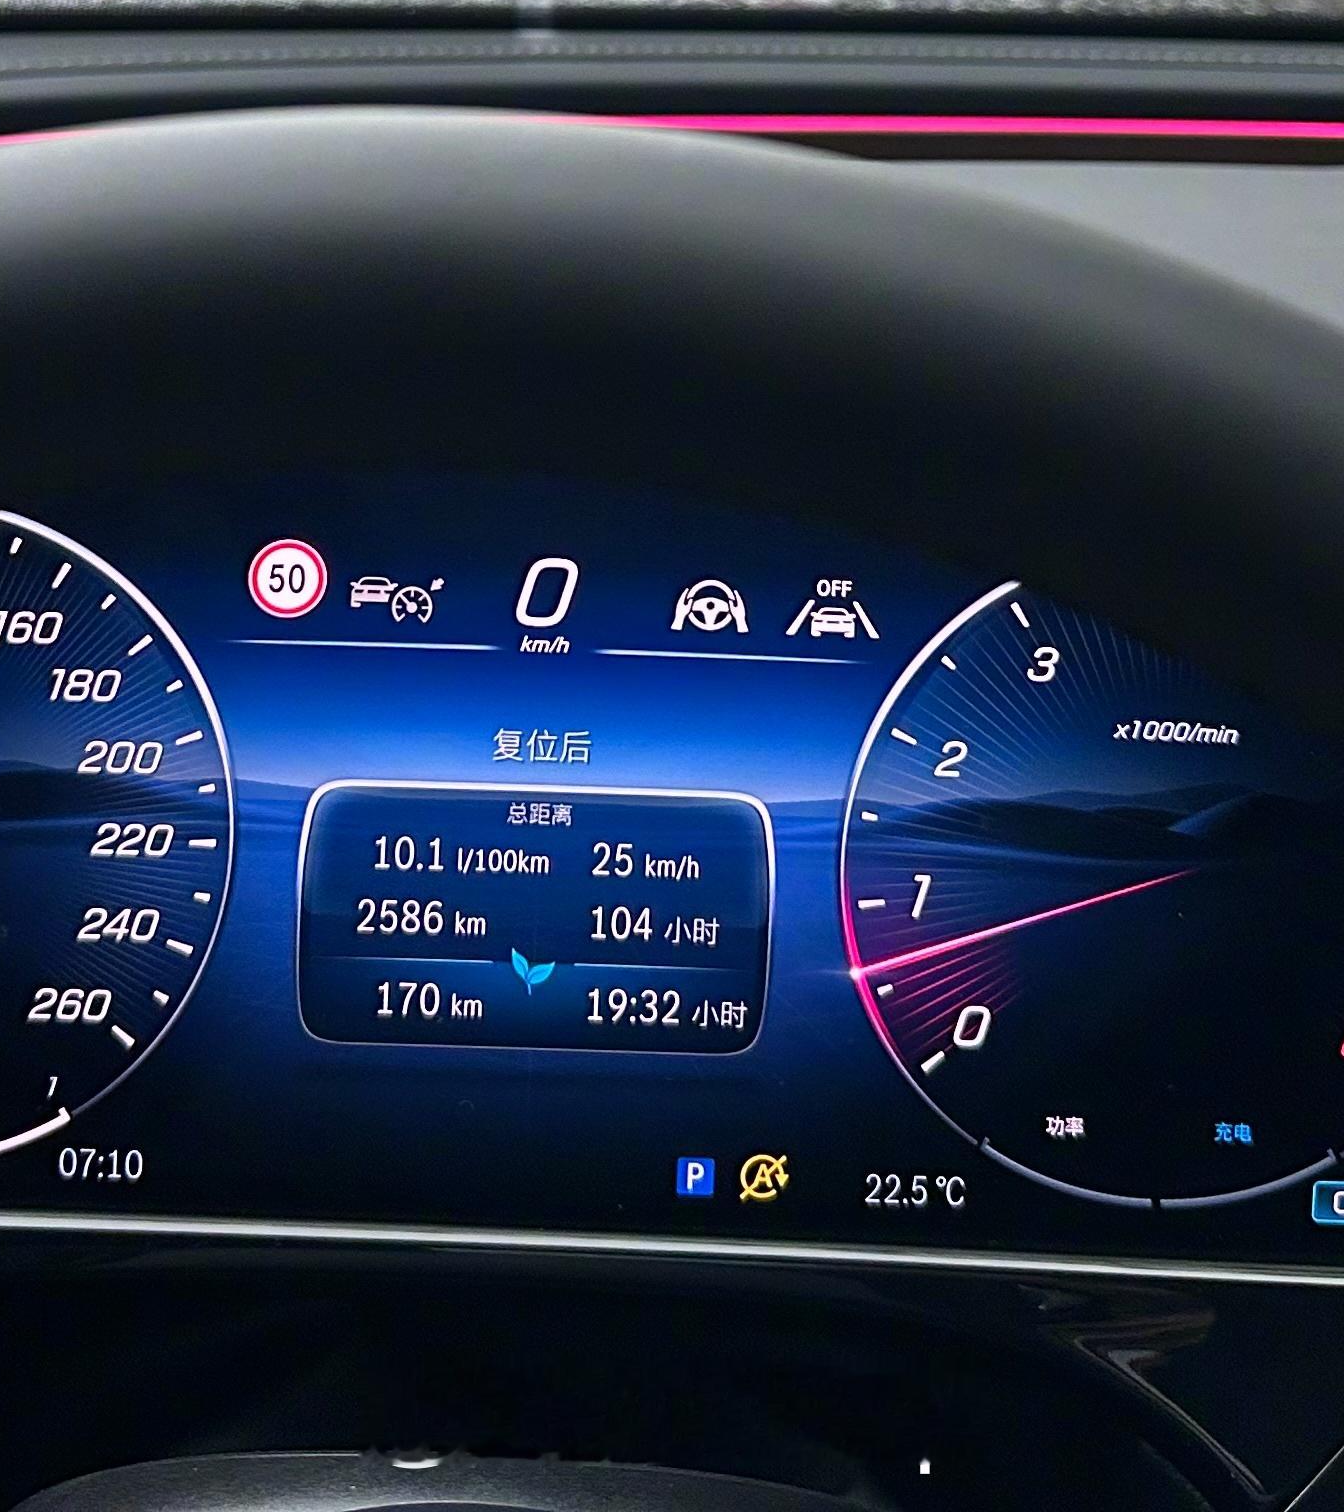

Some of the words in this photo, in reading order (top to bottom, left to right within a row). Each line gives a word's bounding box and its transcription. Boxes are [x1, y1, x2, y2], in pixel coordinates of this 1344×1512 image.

[269, 564, 305, 593] 50
[516, 558, 578, 626] 0
[816, 580, 852, 598] OFF
[520, 635, 569, 653] km/h
[1027, 647, 1059, 682] 3
[50, 669, 121, 703] 180
[492, 728, 591, 766] 复位后
[1113, 720, 1239, 744] x1000/min
[78, 740, 164, 774] 200
[934, 740, 967, 778] 2
[507, 803, 573, 826] 总距离
[90, 821, 175, 857] 220
[375, 836, 443, 871] 10.1
[458, 848, 549, 874] l/100km
[592, 842, 632, 877] 25
[645, 854, 699, 881] km/h
[912, 875, 931, 919] 1
[77, 906, 160, 942] 240
[357, 899, 443, 935] 2586
[455, 911, 485, 935] km
[591, 906, 652, 941] 104
[664, 916, 720, 945] 小时
[28, 988, 112, 1023] 260
[378, 982, 439, 1016] 170
[452, 993, 482, 1018] km
[588, 988, 679, 1023] 19:32
[692, 1000, 747, 1028] 小时
[954, 1003, 991, 1047] 0
[48, 1077, 57, 1097] 1
[1046, 1116, 1083, 1136] 功率
[1215, 1122, 1251, 1143] 充电
[59, 1148, 142, 1179] 07:10
[686, 1161, 705, 1191] P
